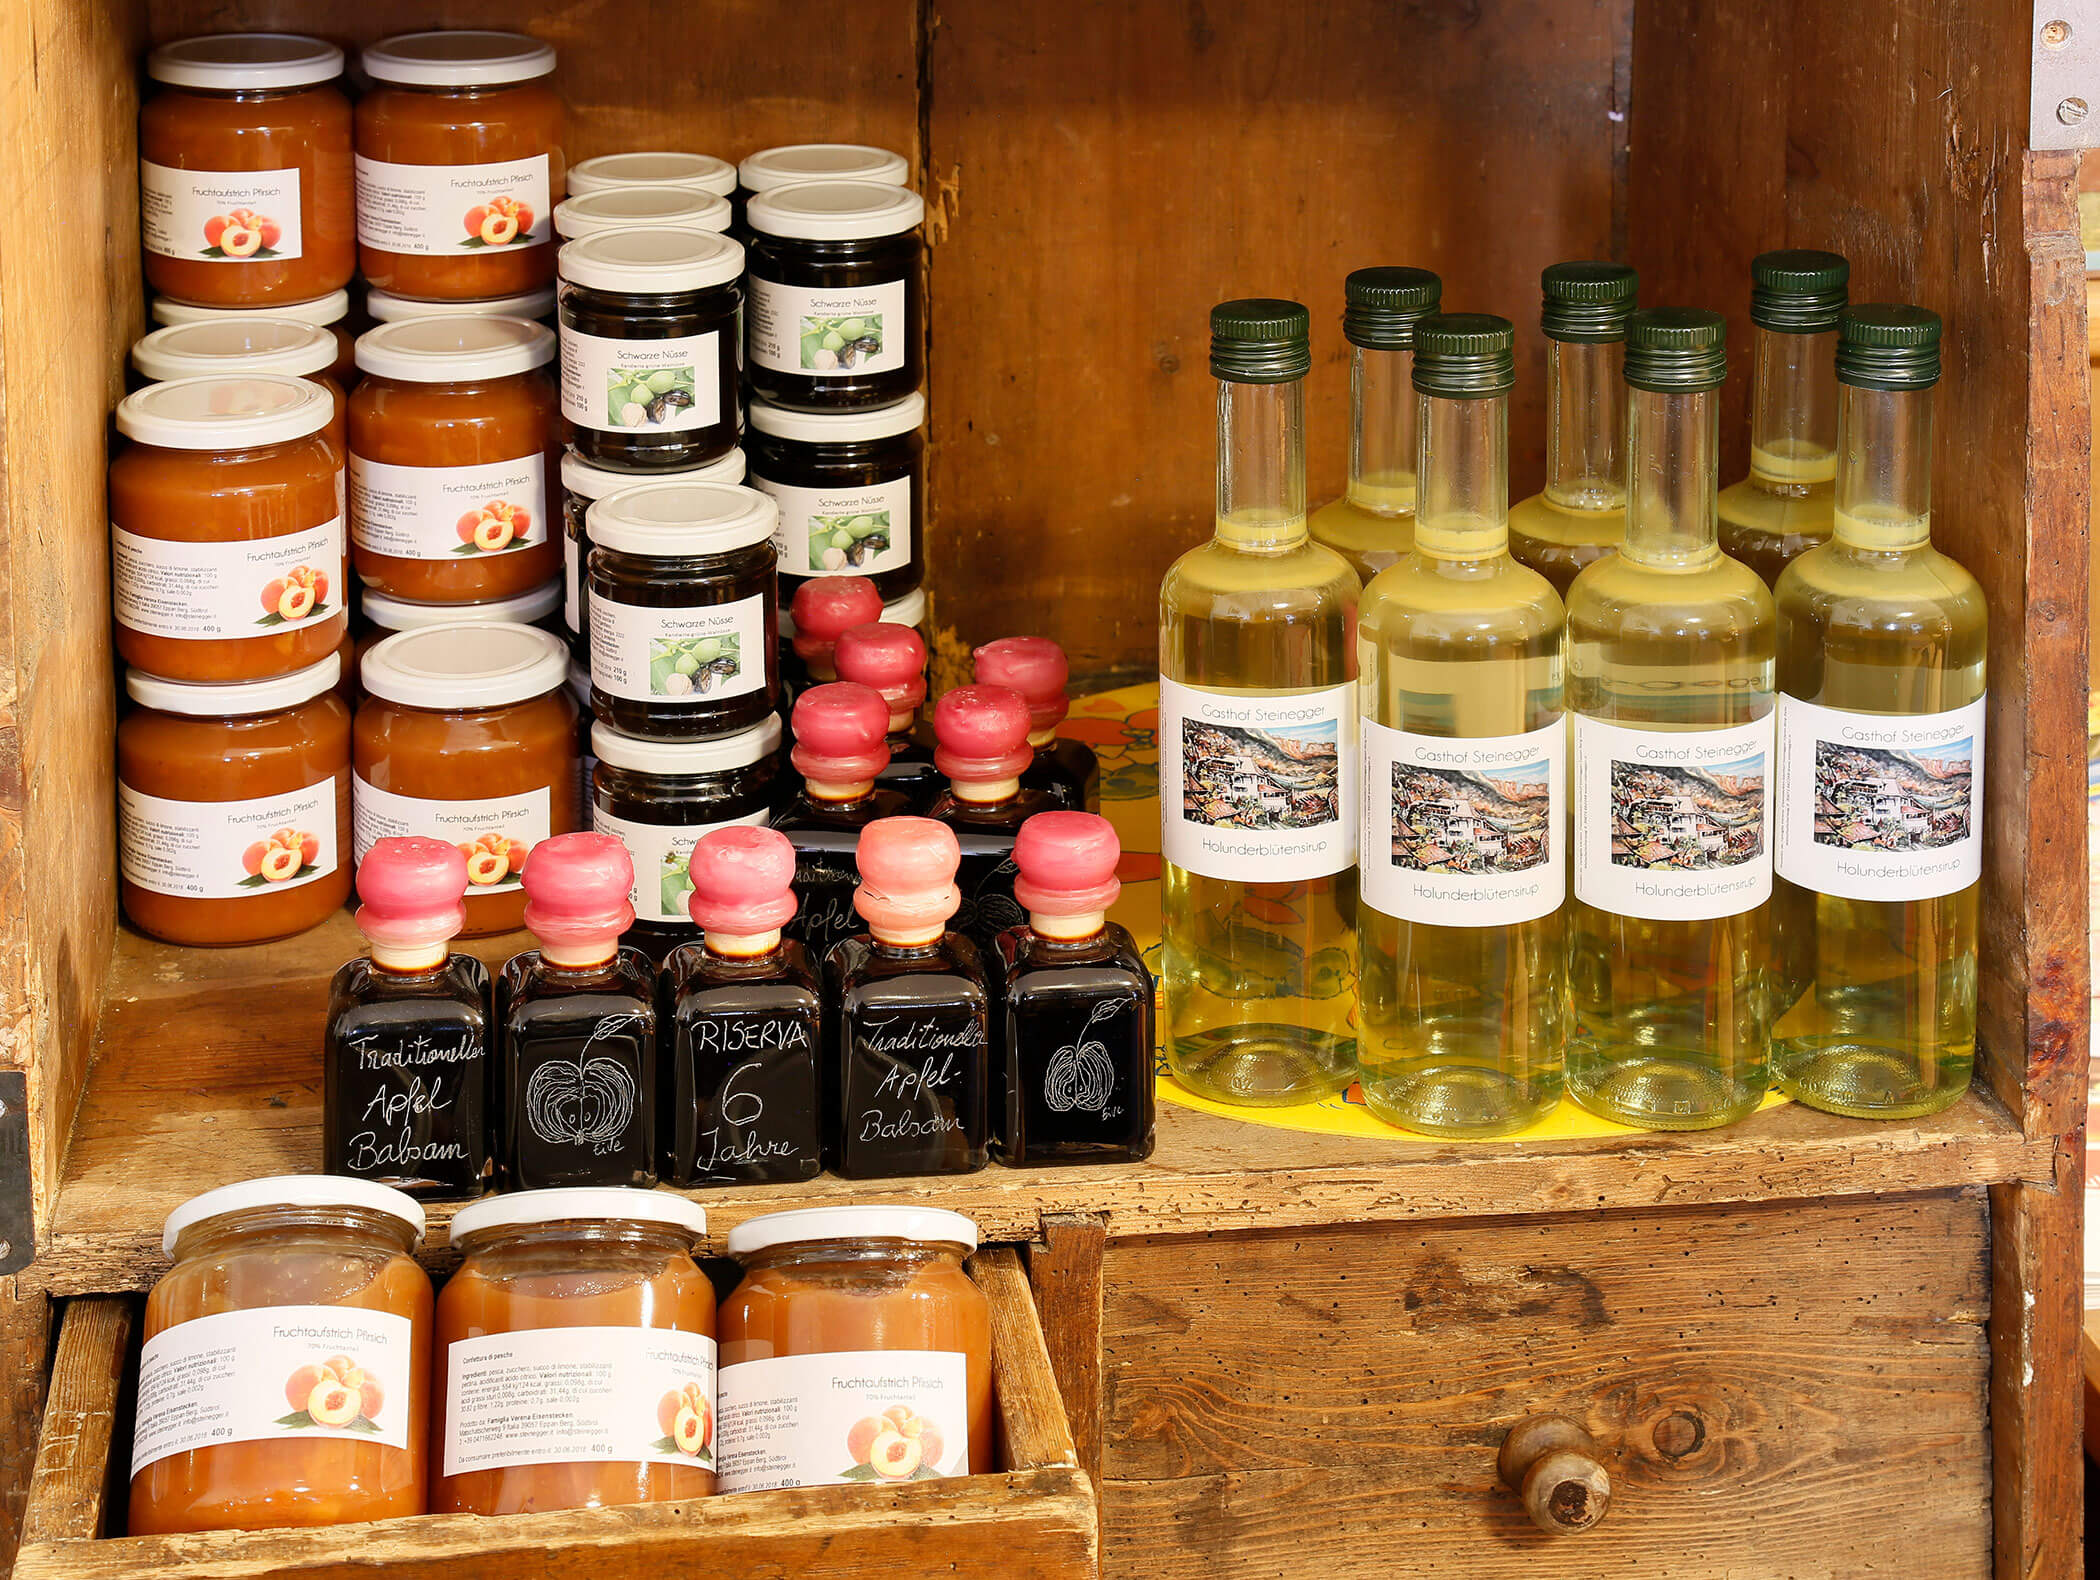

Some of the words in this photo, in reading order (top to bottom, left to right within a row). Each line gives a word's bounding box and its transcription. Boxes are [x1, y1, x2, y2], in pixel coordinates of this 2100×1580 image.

[450, 177, 508, 188] Fruchtaufstrich
[510, 173, 533, 183] Pfirsich
[192, 186, 250, 198] Fruchtaufstrich
[252, 188, 280, 198] Pfirsich
[810, 298, 850, 308] Schwarze
[852, 298, 877, 307] Nüsse
[616, 350, 660, 360] Schwarze
[662, 350, 688, 360] Nüsse
[442, 481, 503, 492] Fruchtaufstrich
[505, 474, 530, 486] Pfirsich
[818, 498, 860, 507] Schwarze
[861, 496, 884, 505] Nüsse
[247, 546, 307, 562] Fruchtaufstrich
[660, 618, 706, 628] Schwarze
[708, 616, 734, 626] Nüsse
[1201, 703, 1250, 721] Gasthof
[1255, 705, 1326, 722] Steinegger
[1841, 726, 1897, 743] Gasthof
[1902, 724, 1966, 742] Steinegger
[1414, 746, 1469, 764] Gasthof
[1472, 746, 1540, 764] Steinegger
[1635, 744, 1691, 760] Gasthof
[1694, 740, 1758, 758] Steinegger
[227, 808, 292, 824] Fruchtaufstrich
[292, 800, 319, 816] Pfirsich
[435, 814, 498, 824] Fruchtaufstrich
[500, 808, 530, 820] Pfirsich
[1202, 838, 1328, 856] Holunderblütensirup
[1836, 858, 1962, 878] Holunderblütensirup
[1412, 882, 1540, 902] Holunderblütensirup
[1635, 876, 1757, 898] Holunderblütensirup
[690, 1020, 808, 1054] RISERVA
[862, 1015, 989, 1051] Traditioneller
[348, 1034, 486, 1070] Traditioneller
[362, 1076, 453, 1127] Apfel
[722, 1062, 763, 1127] 6
[859, 1108, 966, 1142] Balsam
[347, 1126, 470, 1171] Balsam
[696, 1126, 800, 1172] Jahre
[272, 1324, 352, 1340] Fruchtaufstrich
[356, 1328, 388, 1345] Pfirsich
[832, 1376, 910, 1390] Fruchtaufstrich
[912, 1376, 944, 1390] Pfirsich
[486, 1416, 510, 1426] Famiglia
[510, 1414, 531, 1422] Verena
[211, 1428, 226, 1437] 400
[227, 1428, 234, 1437] g
[590, 1444, 606, 1452] 400
[607, 1446, 613, 1454] g
[780, 1478, 794, 1487] 400
